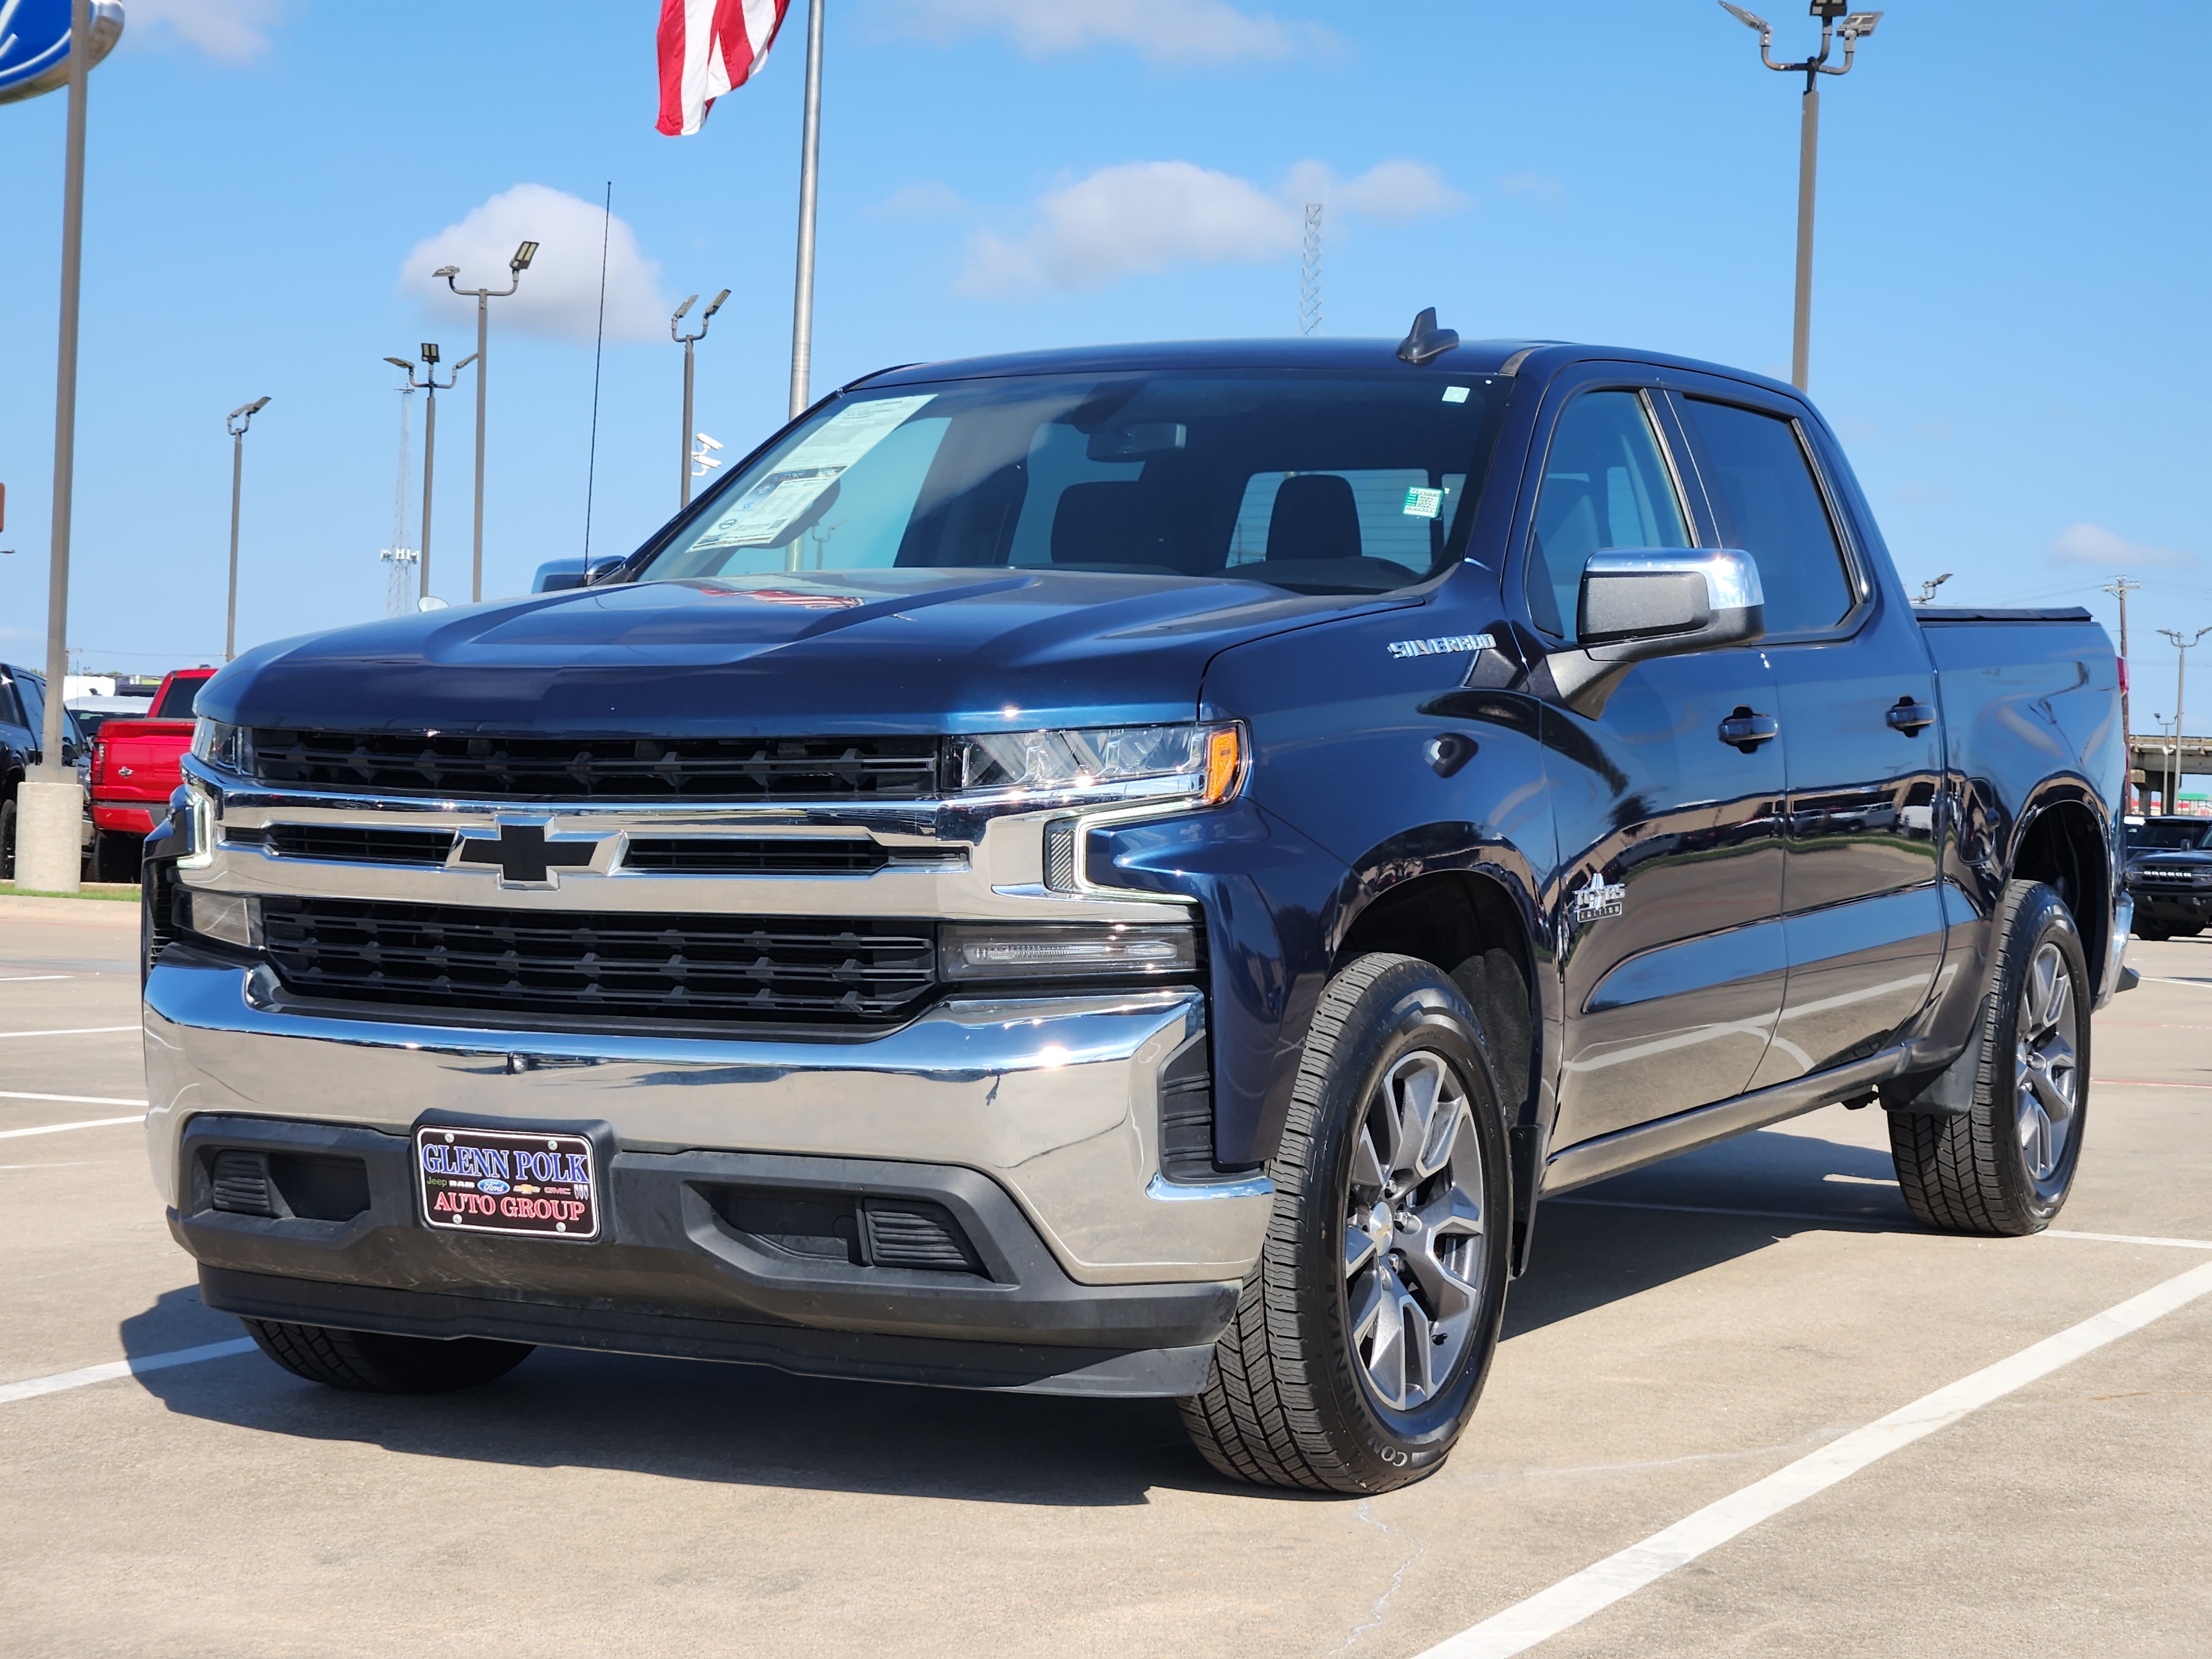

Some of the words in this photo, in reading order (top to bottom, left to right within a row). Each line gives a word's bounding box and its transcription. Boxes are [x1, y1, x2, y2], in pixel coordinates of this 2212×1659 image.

[1387, 634, 1496, 659] SILVERADO
[1580, 905, 1619, 919] EDITION
[422, 1144, 509, 1179] GLENN
[514, 1150, 590, 1183] POLK
[426, 1176, 447, 1187] Jeep
[448, 1180, 475, 1188] RAM
[483, 1181, 504, 1192] Ford
[544, 1186, 571, 1194] GMC
[434, 1191, 496, 1215] AUTO
[500, 1196, 585, 1221] GROUP
